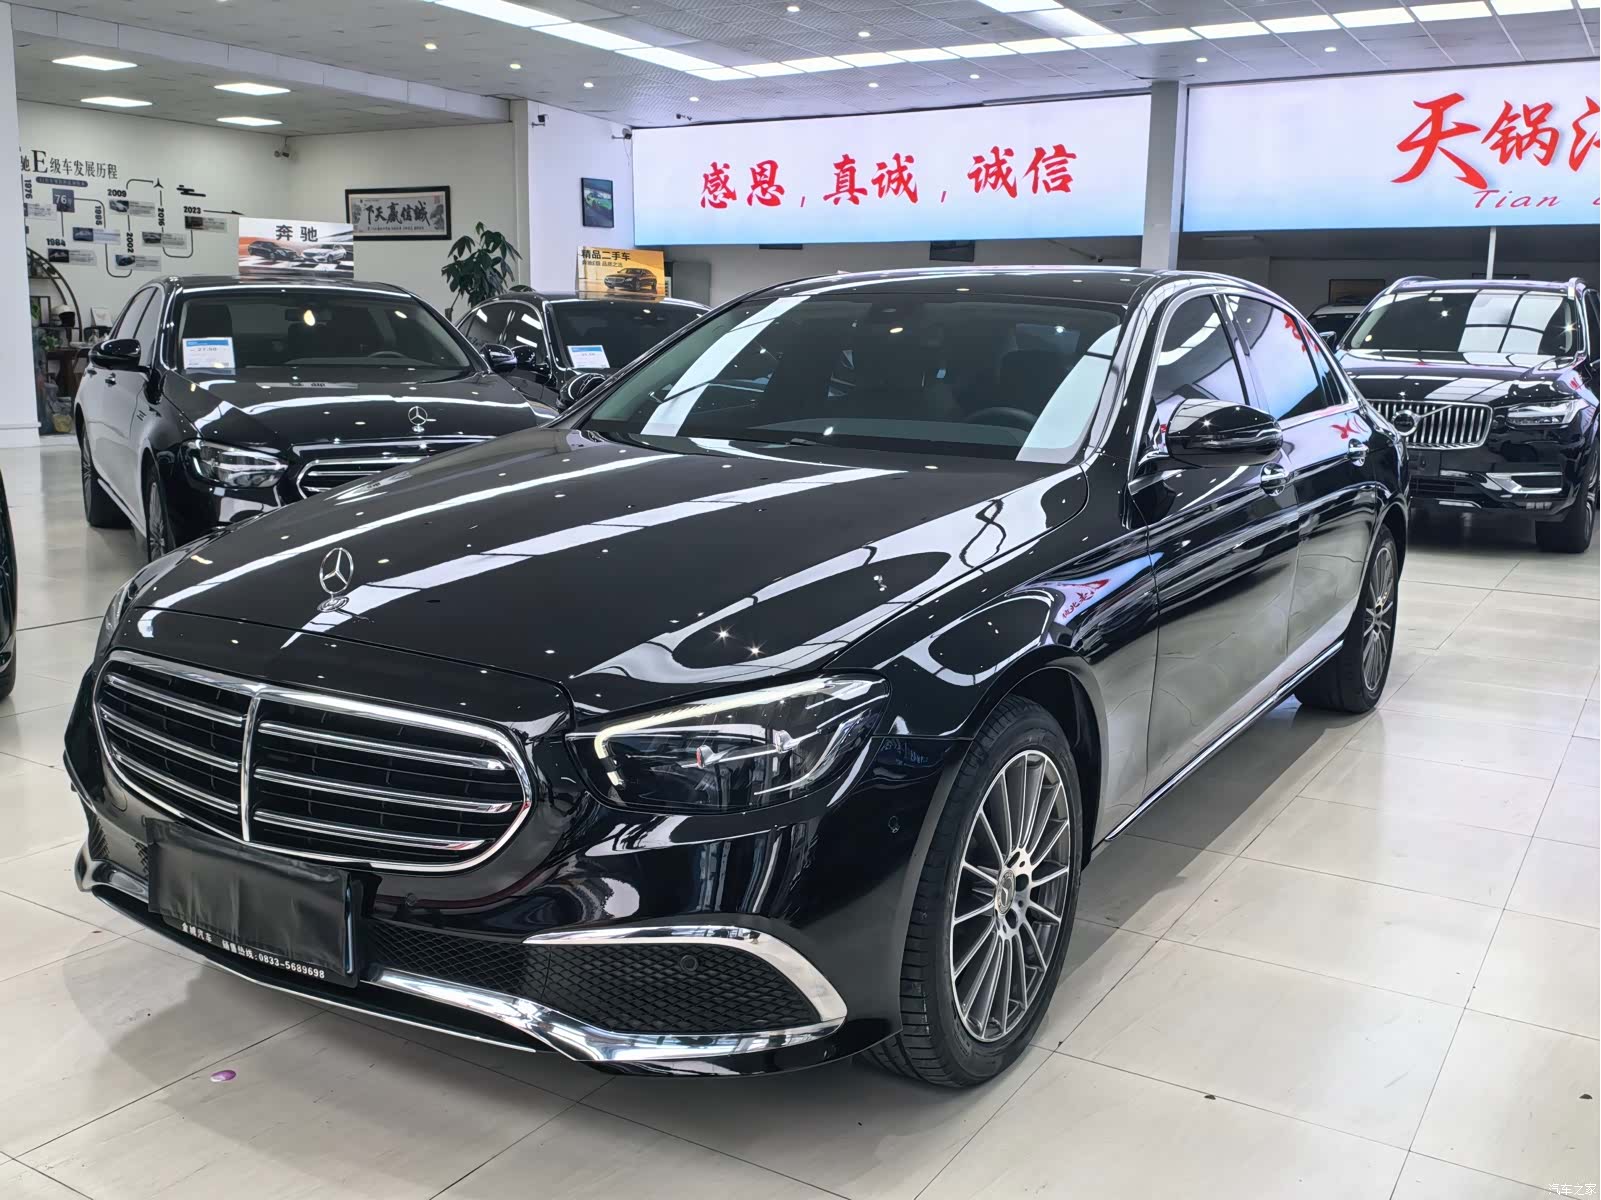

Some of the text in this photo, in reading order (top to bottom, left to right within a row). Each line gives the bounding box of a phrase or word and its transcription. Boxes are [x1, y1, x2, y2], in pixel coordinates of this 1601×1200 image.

[24, 179, 33, 200] 1976
[107, 189, 127, 198] 2009
[1472, 189, 1561, 209] Tian
[158, 207, 166, 227] 2016
[183, 206, 202, 215] 2023
[126, 232, 135, 254] 2002
[275, 224, 319, 243] 奔驰
[581, 249, 631, 261] 精品二手车
